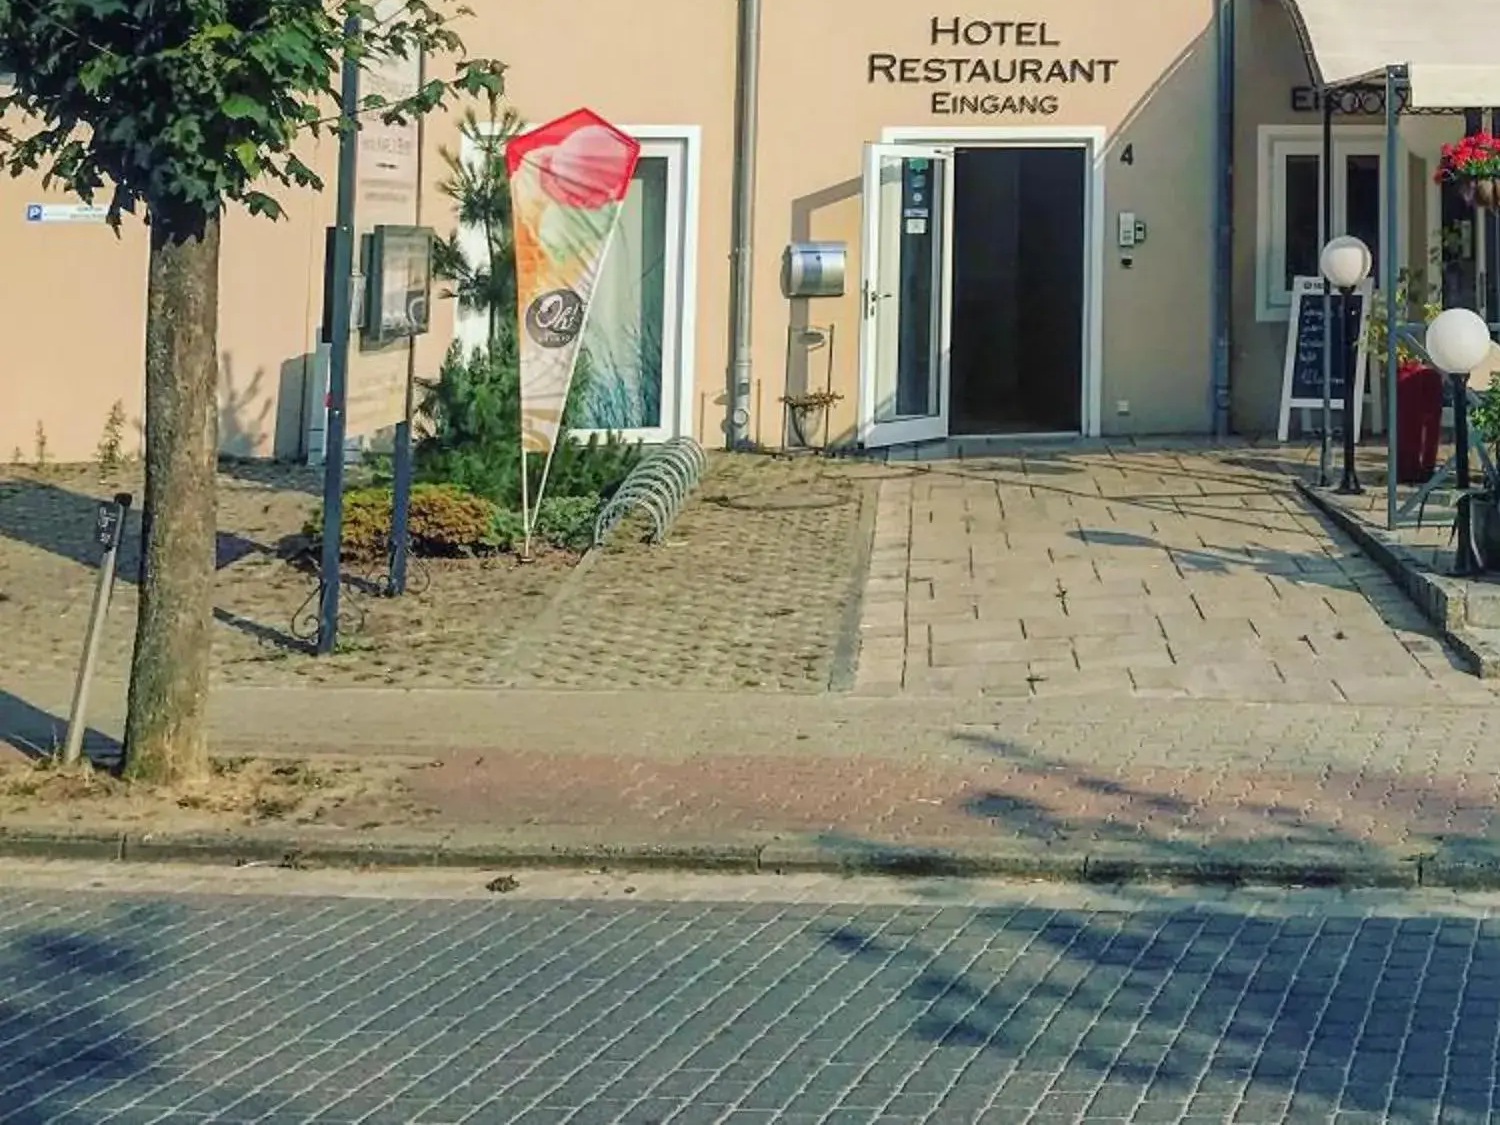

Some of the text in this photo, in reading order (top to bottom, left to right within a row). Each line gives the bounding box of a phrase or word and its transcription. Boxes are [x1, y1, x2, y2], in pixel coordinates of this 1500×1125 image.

[930, 16, 1060, 46] HOTEL
[867, 53, 1119, 84] RESTAURANT
[931, 92, 1059, 115] EINGANG
[1119, 143, 1134, 166] 4
